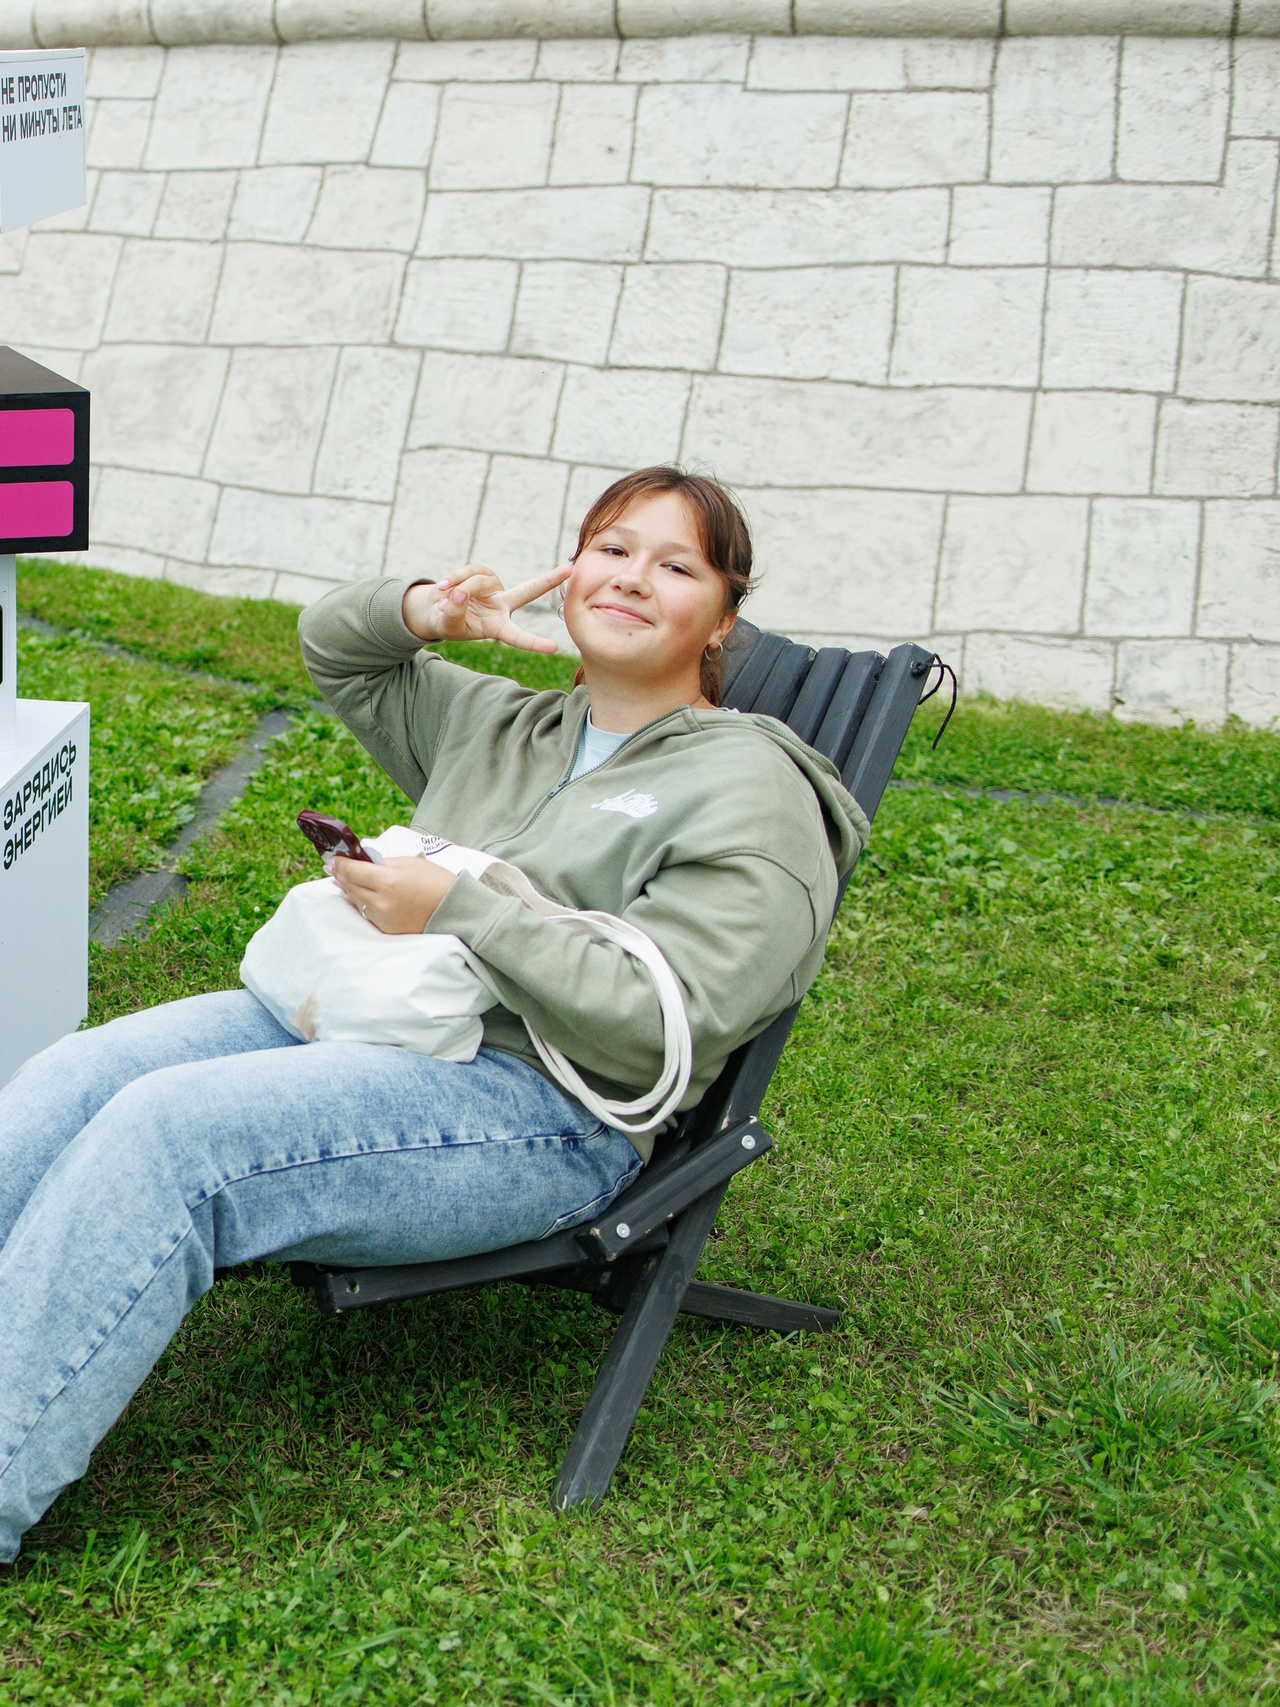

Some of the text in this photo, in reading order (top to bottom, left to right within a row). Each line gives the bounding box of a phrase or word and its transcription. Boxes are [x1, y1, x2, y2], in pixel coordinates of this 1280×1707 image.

[1, 72, 67, 105] НЕ ПРОПУСТИ
[2, 104, 83, 143] НИ МИНУТЫ ЛЕТА
[3, 739, 77, 831] ЗАРЯДИСЬ
[3, 767, 73, 871] ЭНЕРГИЕЙ
